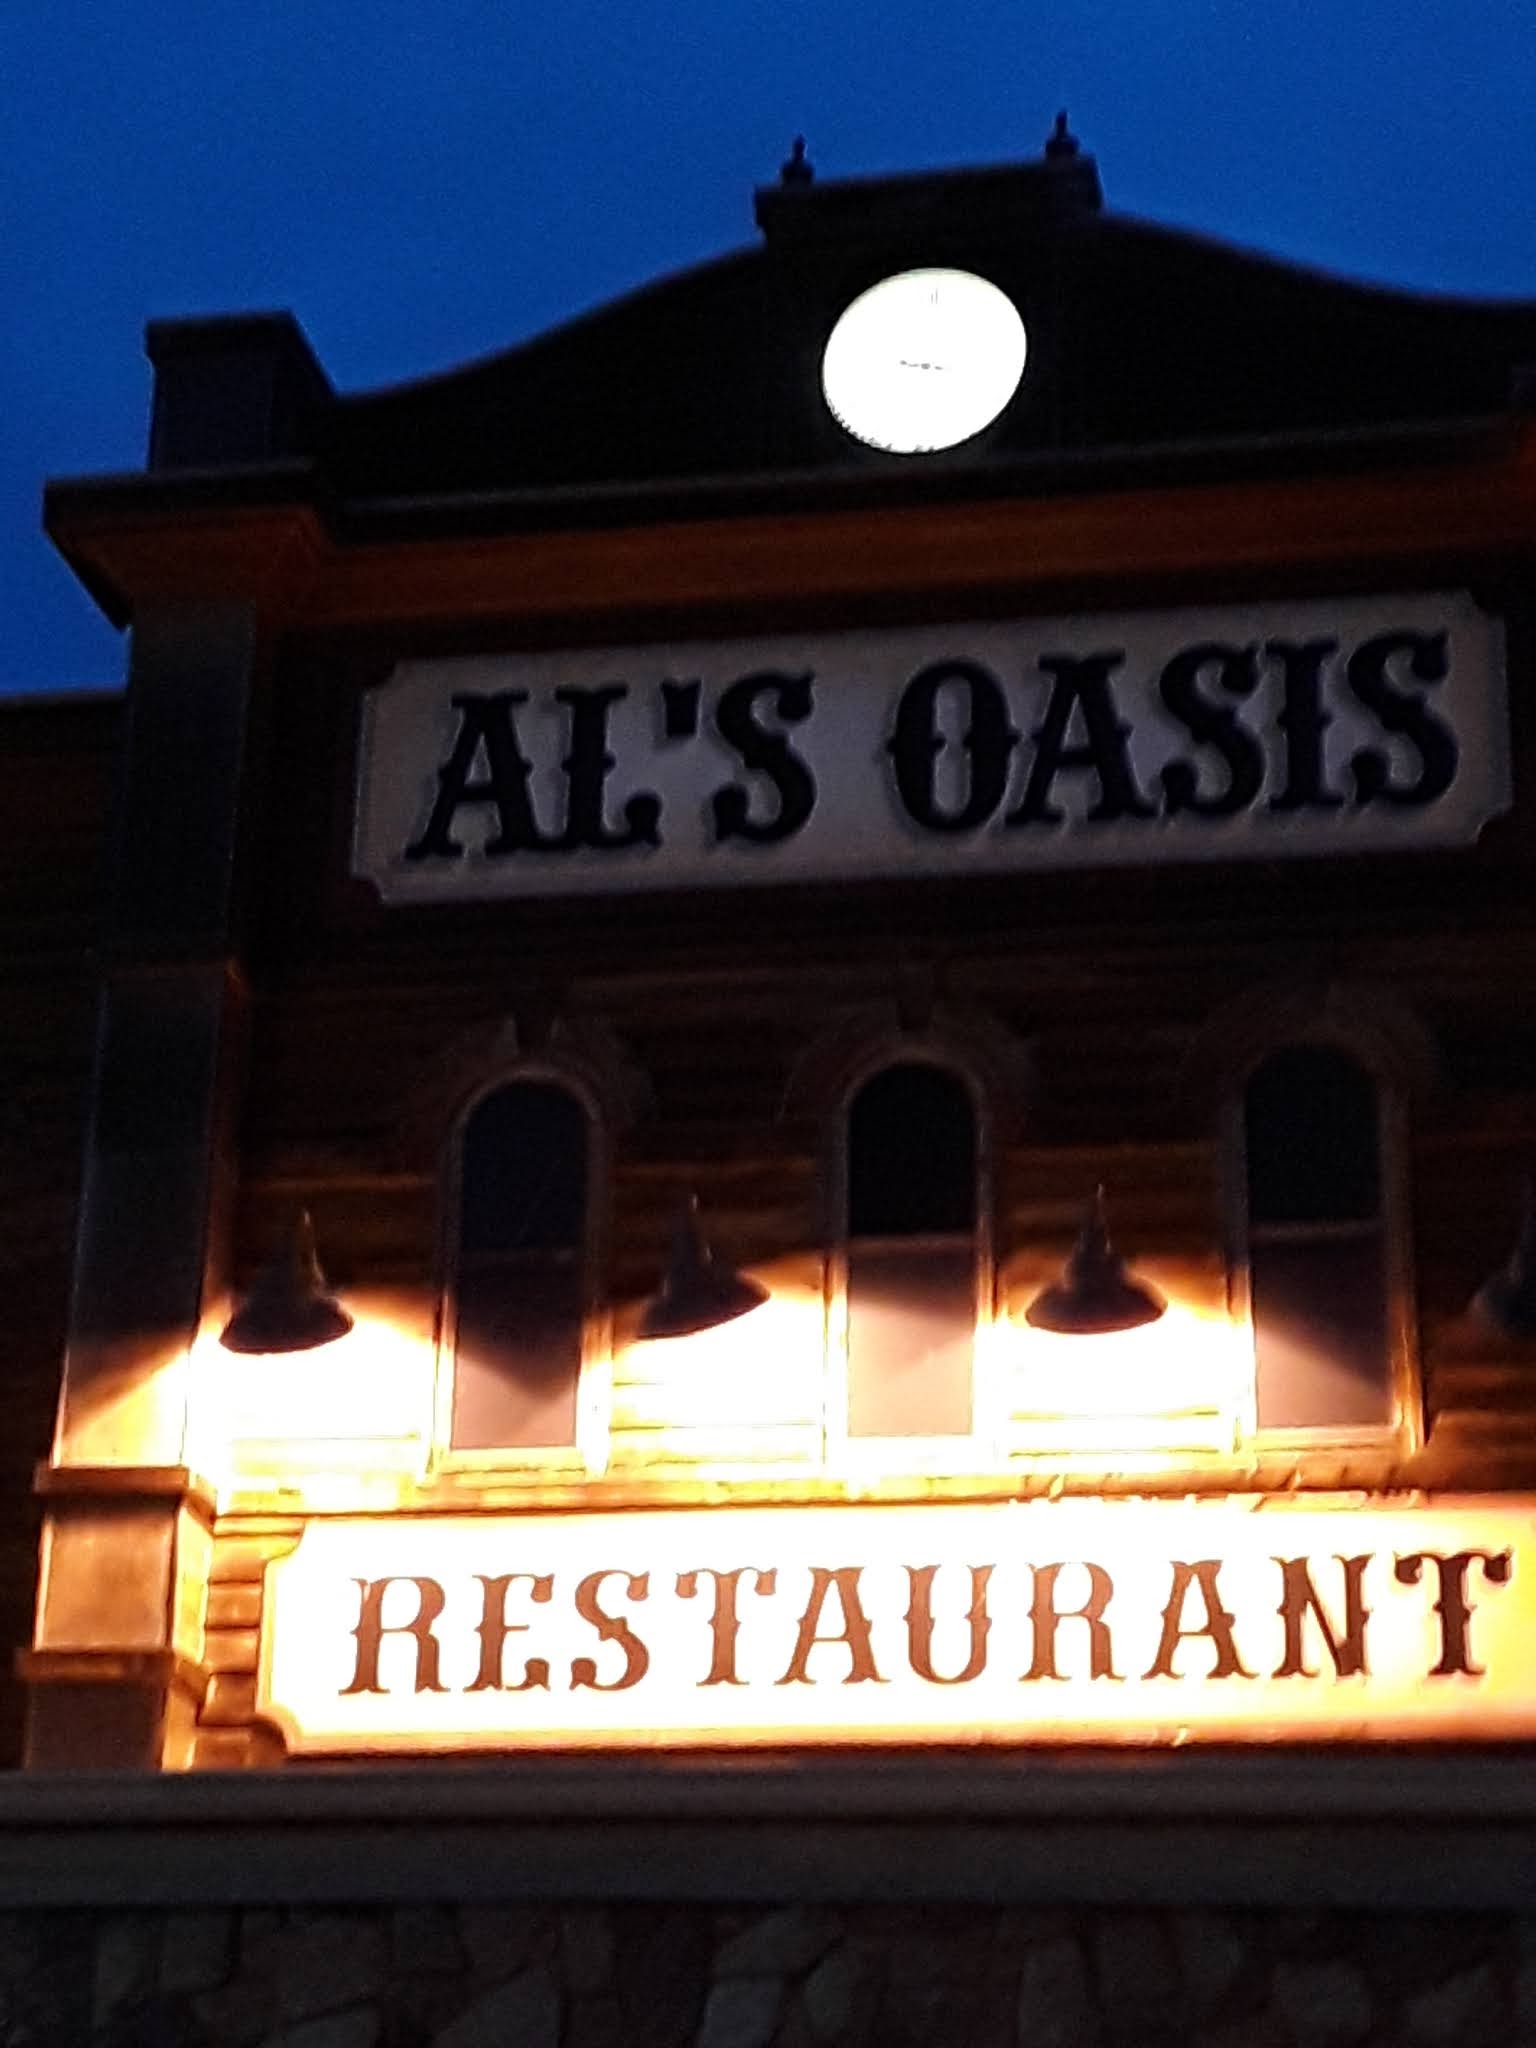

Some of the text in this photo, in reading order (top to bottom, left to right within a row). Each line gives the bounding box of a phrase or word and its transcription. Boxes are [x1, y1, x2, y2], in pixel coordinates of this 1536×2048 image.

[406, 633, 1458, 858] AL'S OASIS
[338, 1547, 1512, 1694] RESTAURANT
